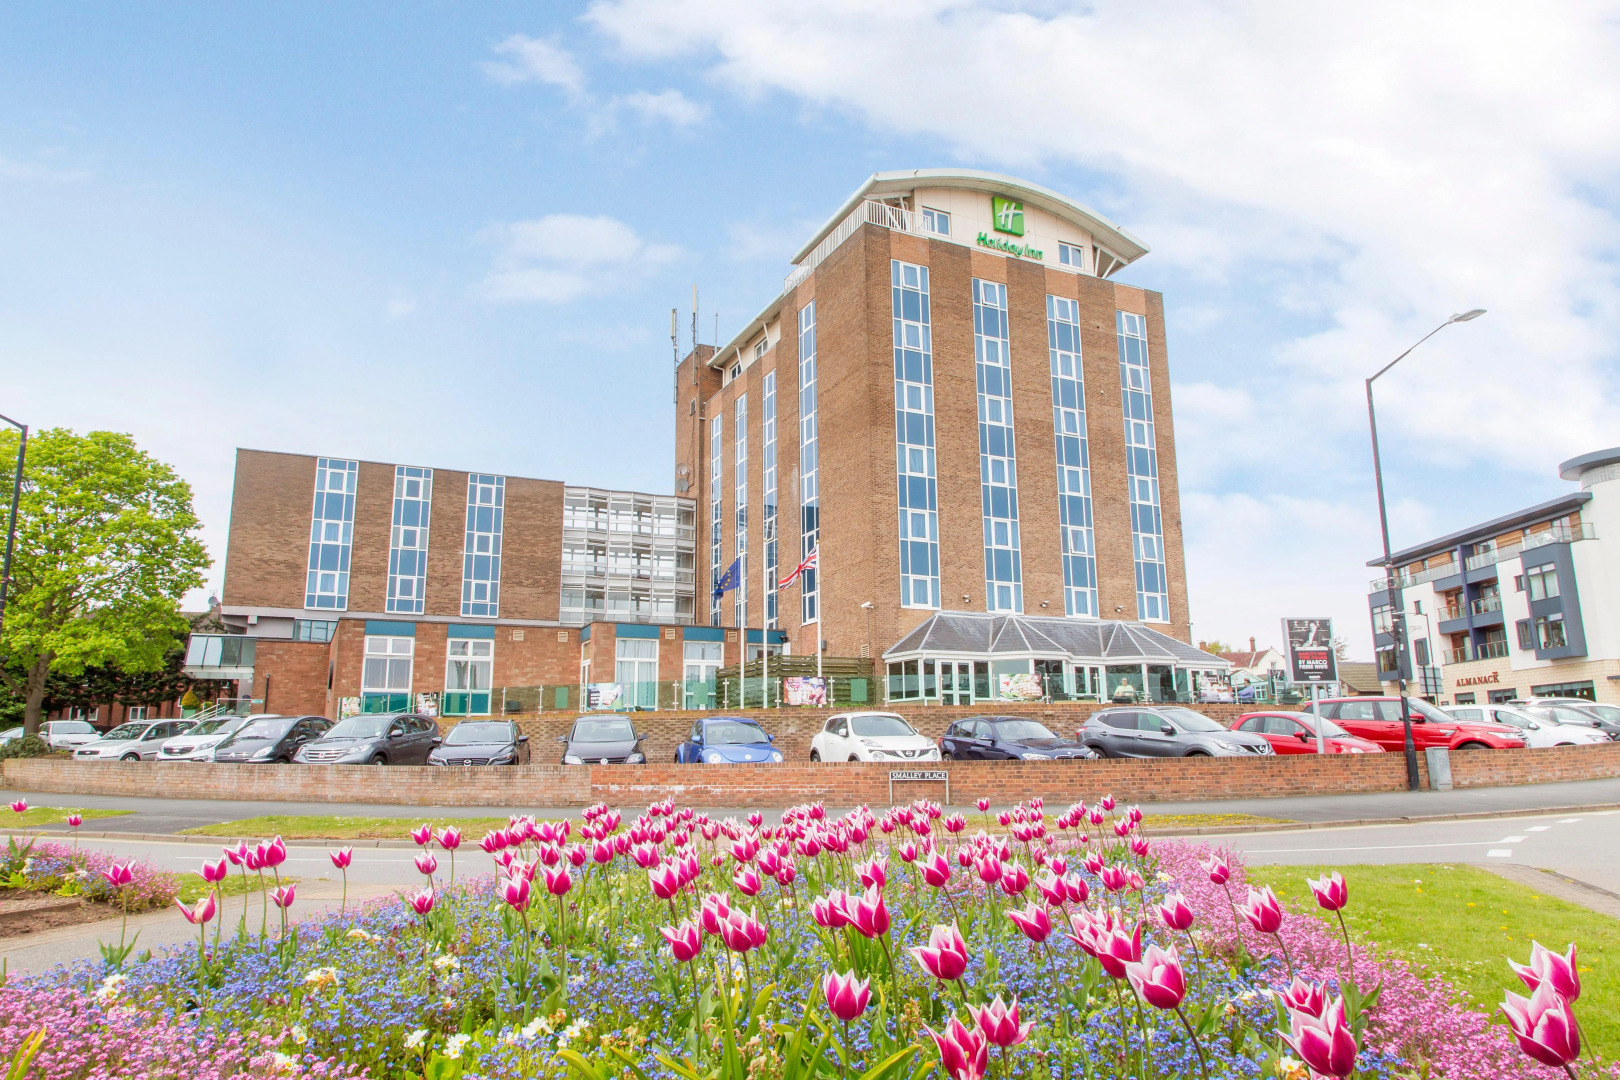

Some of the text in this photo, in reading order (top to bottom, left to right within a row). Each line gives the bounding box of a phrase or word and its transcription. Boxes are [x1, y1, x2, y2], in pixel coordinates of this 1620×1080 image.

[977, 231, 1043, 260] Holiday Inn
[1456, 674, 1500, 687] ALMANACK
